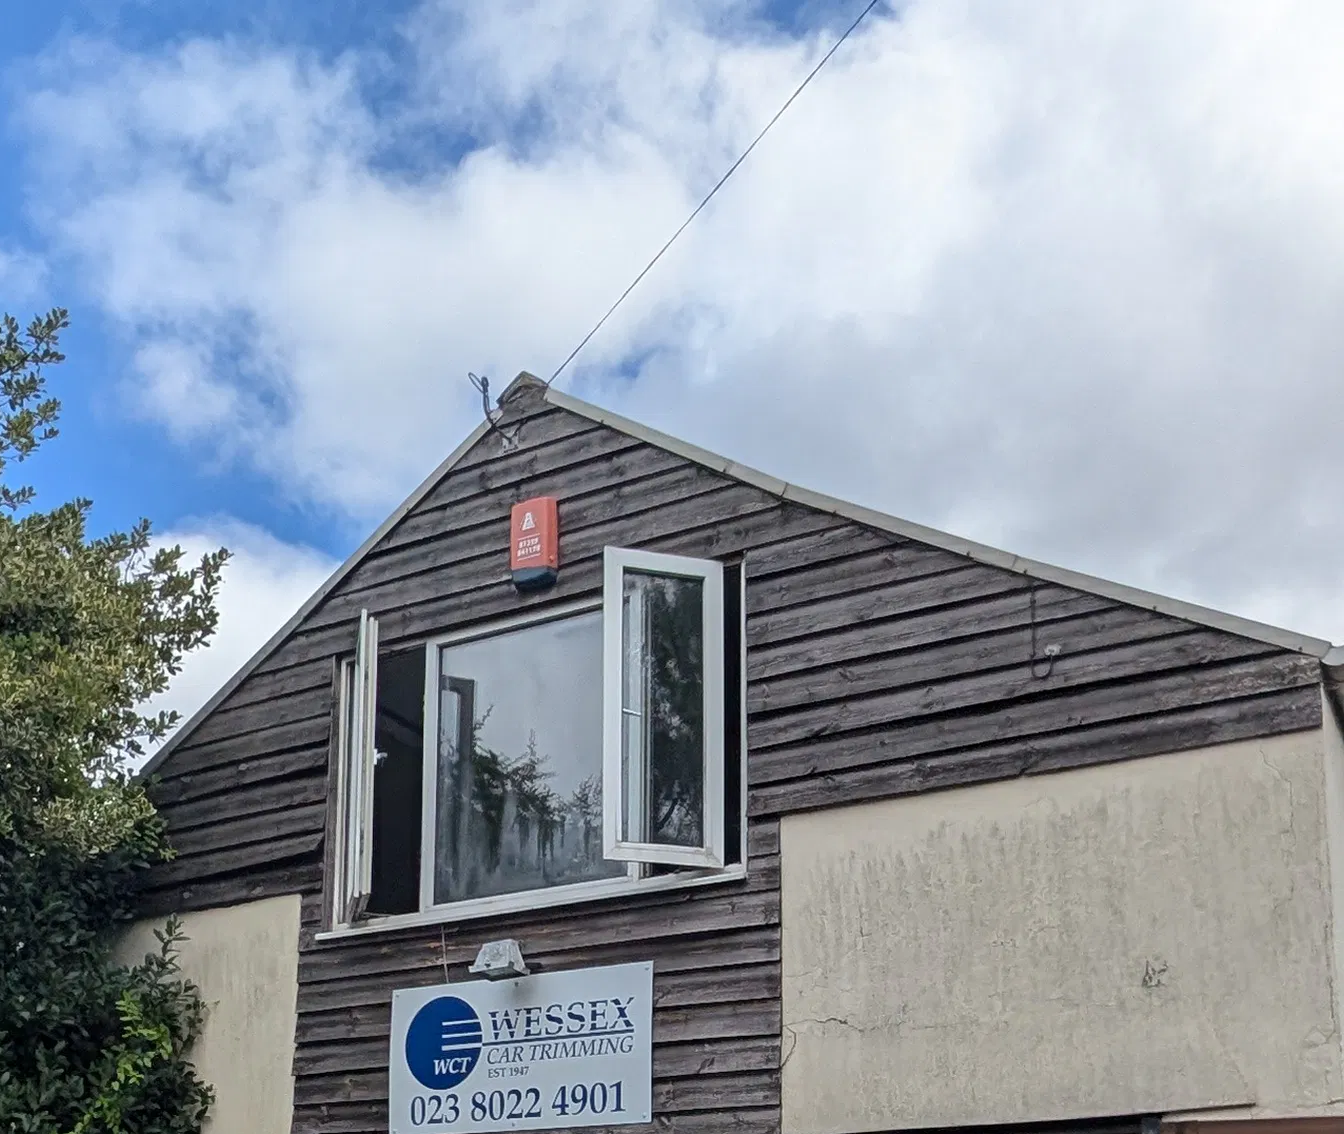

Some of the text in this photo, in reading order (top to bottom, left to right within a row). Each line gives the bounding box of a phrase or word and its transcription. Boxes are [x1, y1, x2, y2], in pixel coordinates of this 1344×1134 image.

[489, 996, 635, 1040] WESSEX
[487, 1035, 634, 1065] CAR TRIMMING
[433, 1057, 473, 1076] WCT
[487, 1066, 507, 1079] EST
[410, 1080, 626, 1126] 023 8022 4901
